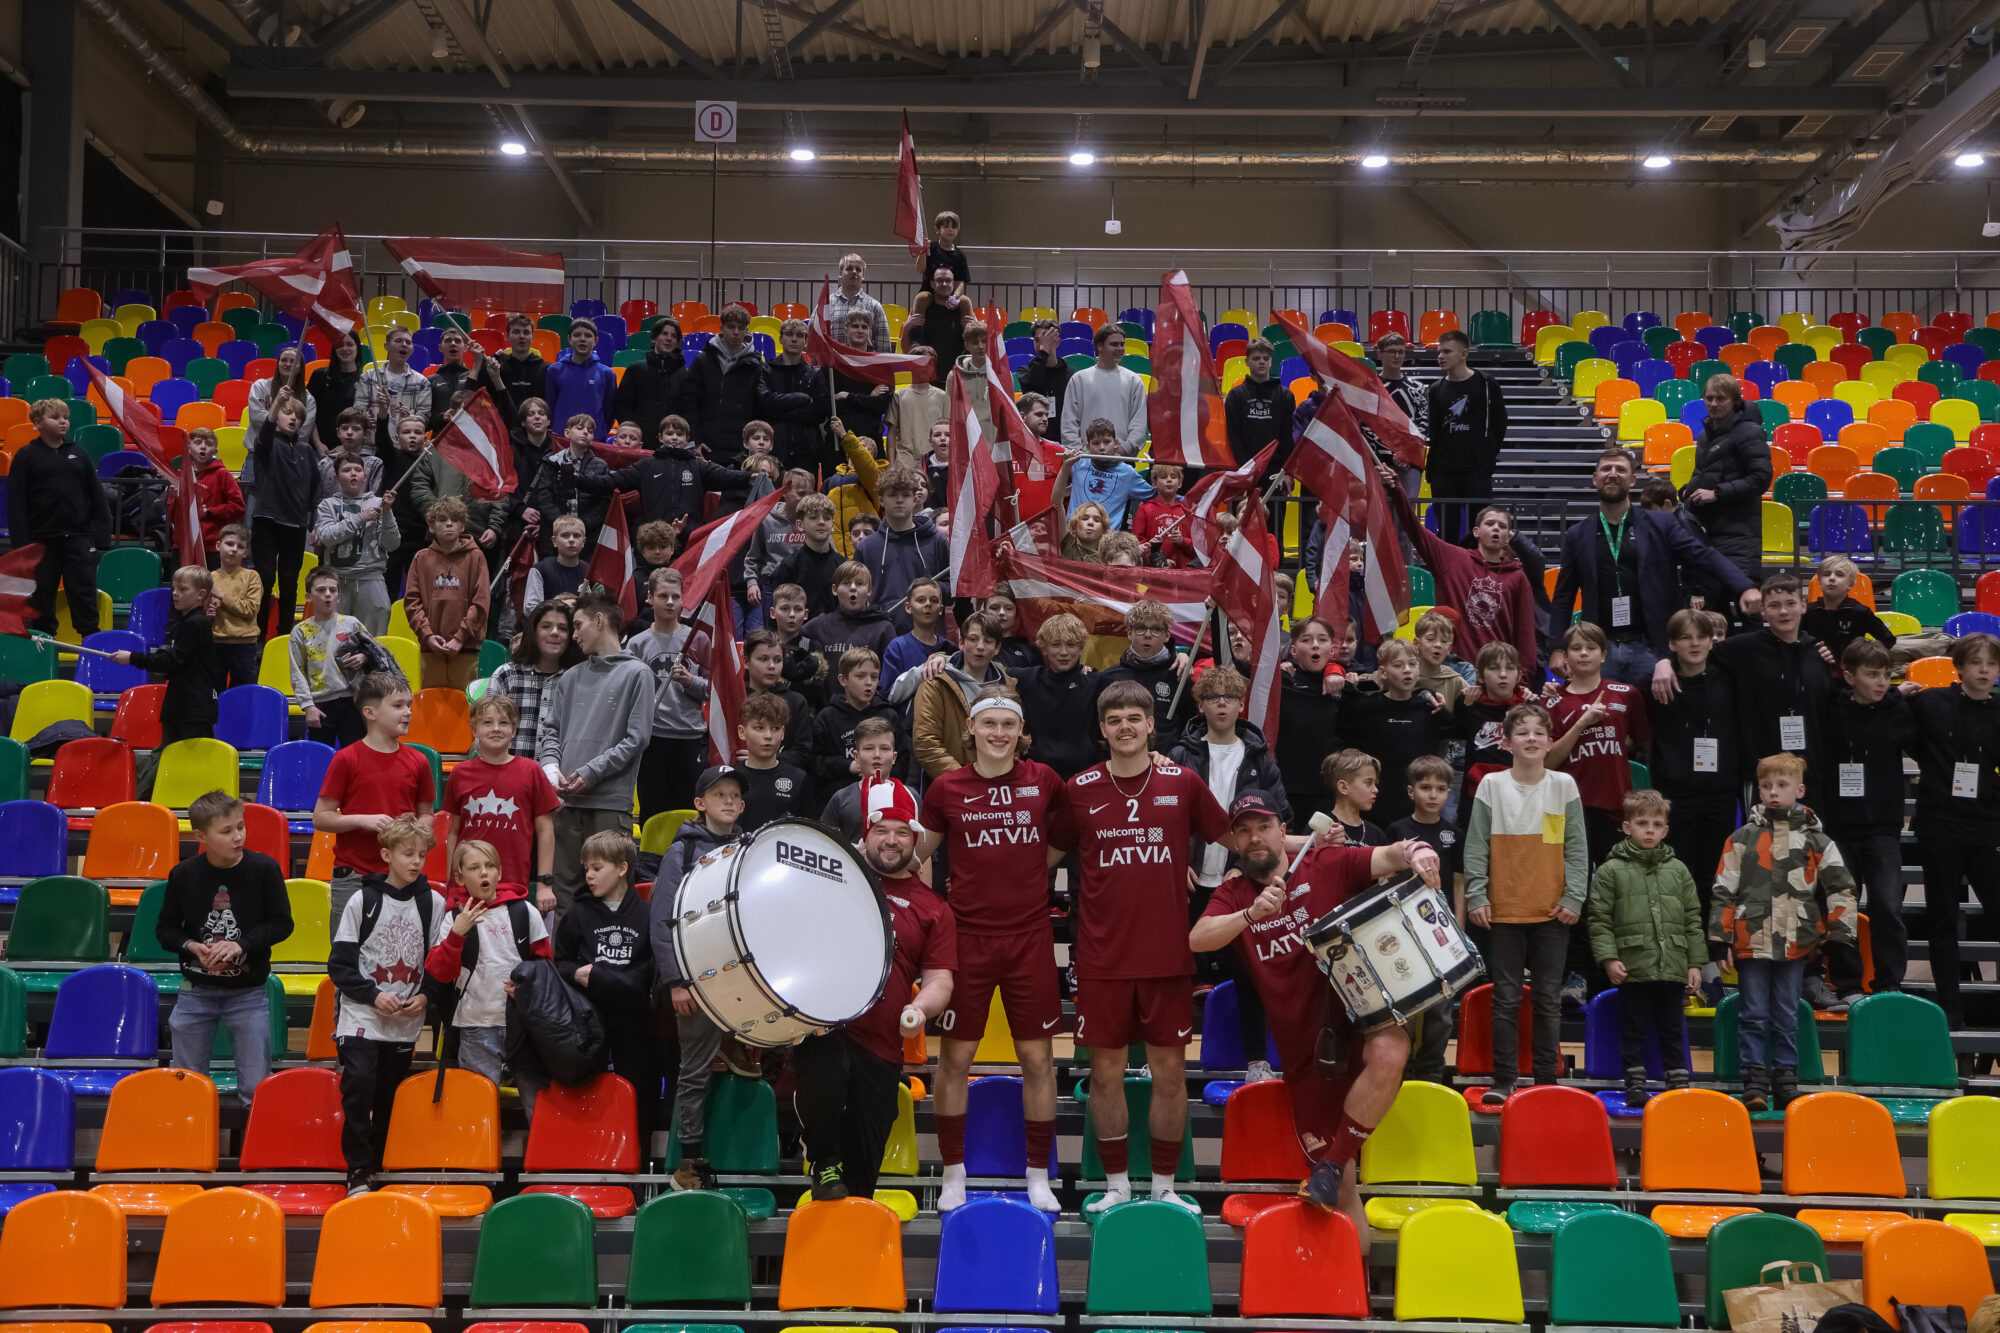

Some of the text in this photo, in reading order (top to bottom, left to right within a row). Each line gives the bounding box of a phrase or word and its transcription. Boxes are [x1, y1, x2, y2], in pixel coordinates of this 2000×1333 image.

[711, 112, 722, 131] D
[768, 533, 806, 543] JUST COO
[825, 642, 846, 652] reāli
[1569, 740, 1622, 763] LATVIA
[1079, 771, 1099, 783] elvi
[987, 785, 1012, 806] 20
[961, 811, 1012, 823] Welcome
[1126, 798, 1140, 822] 2
[1003, 818, 1015, 826] to
[964, 826, 1040, 848] LATVIA
[1096, 827, 1145, 840] Welcome
[1135, 835, 1146, 843] to
[1099, 845, 1173, 868] LATVIA
[1250, 914, 1292, 934] Welcome
[1285, 921, 1297, 931] to
[597, 942, 633, 958] Kurši
[1077, 1015, 1085, 1039] 2
